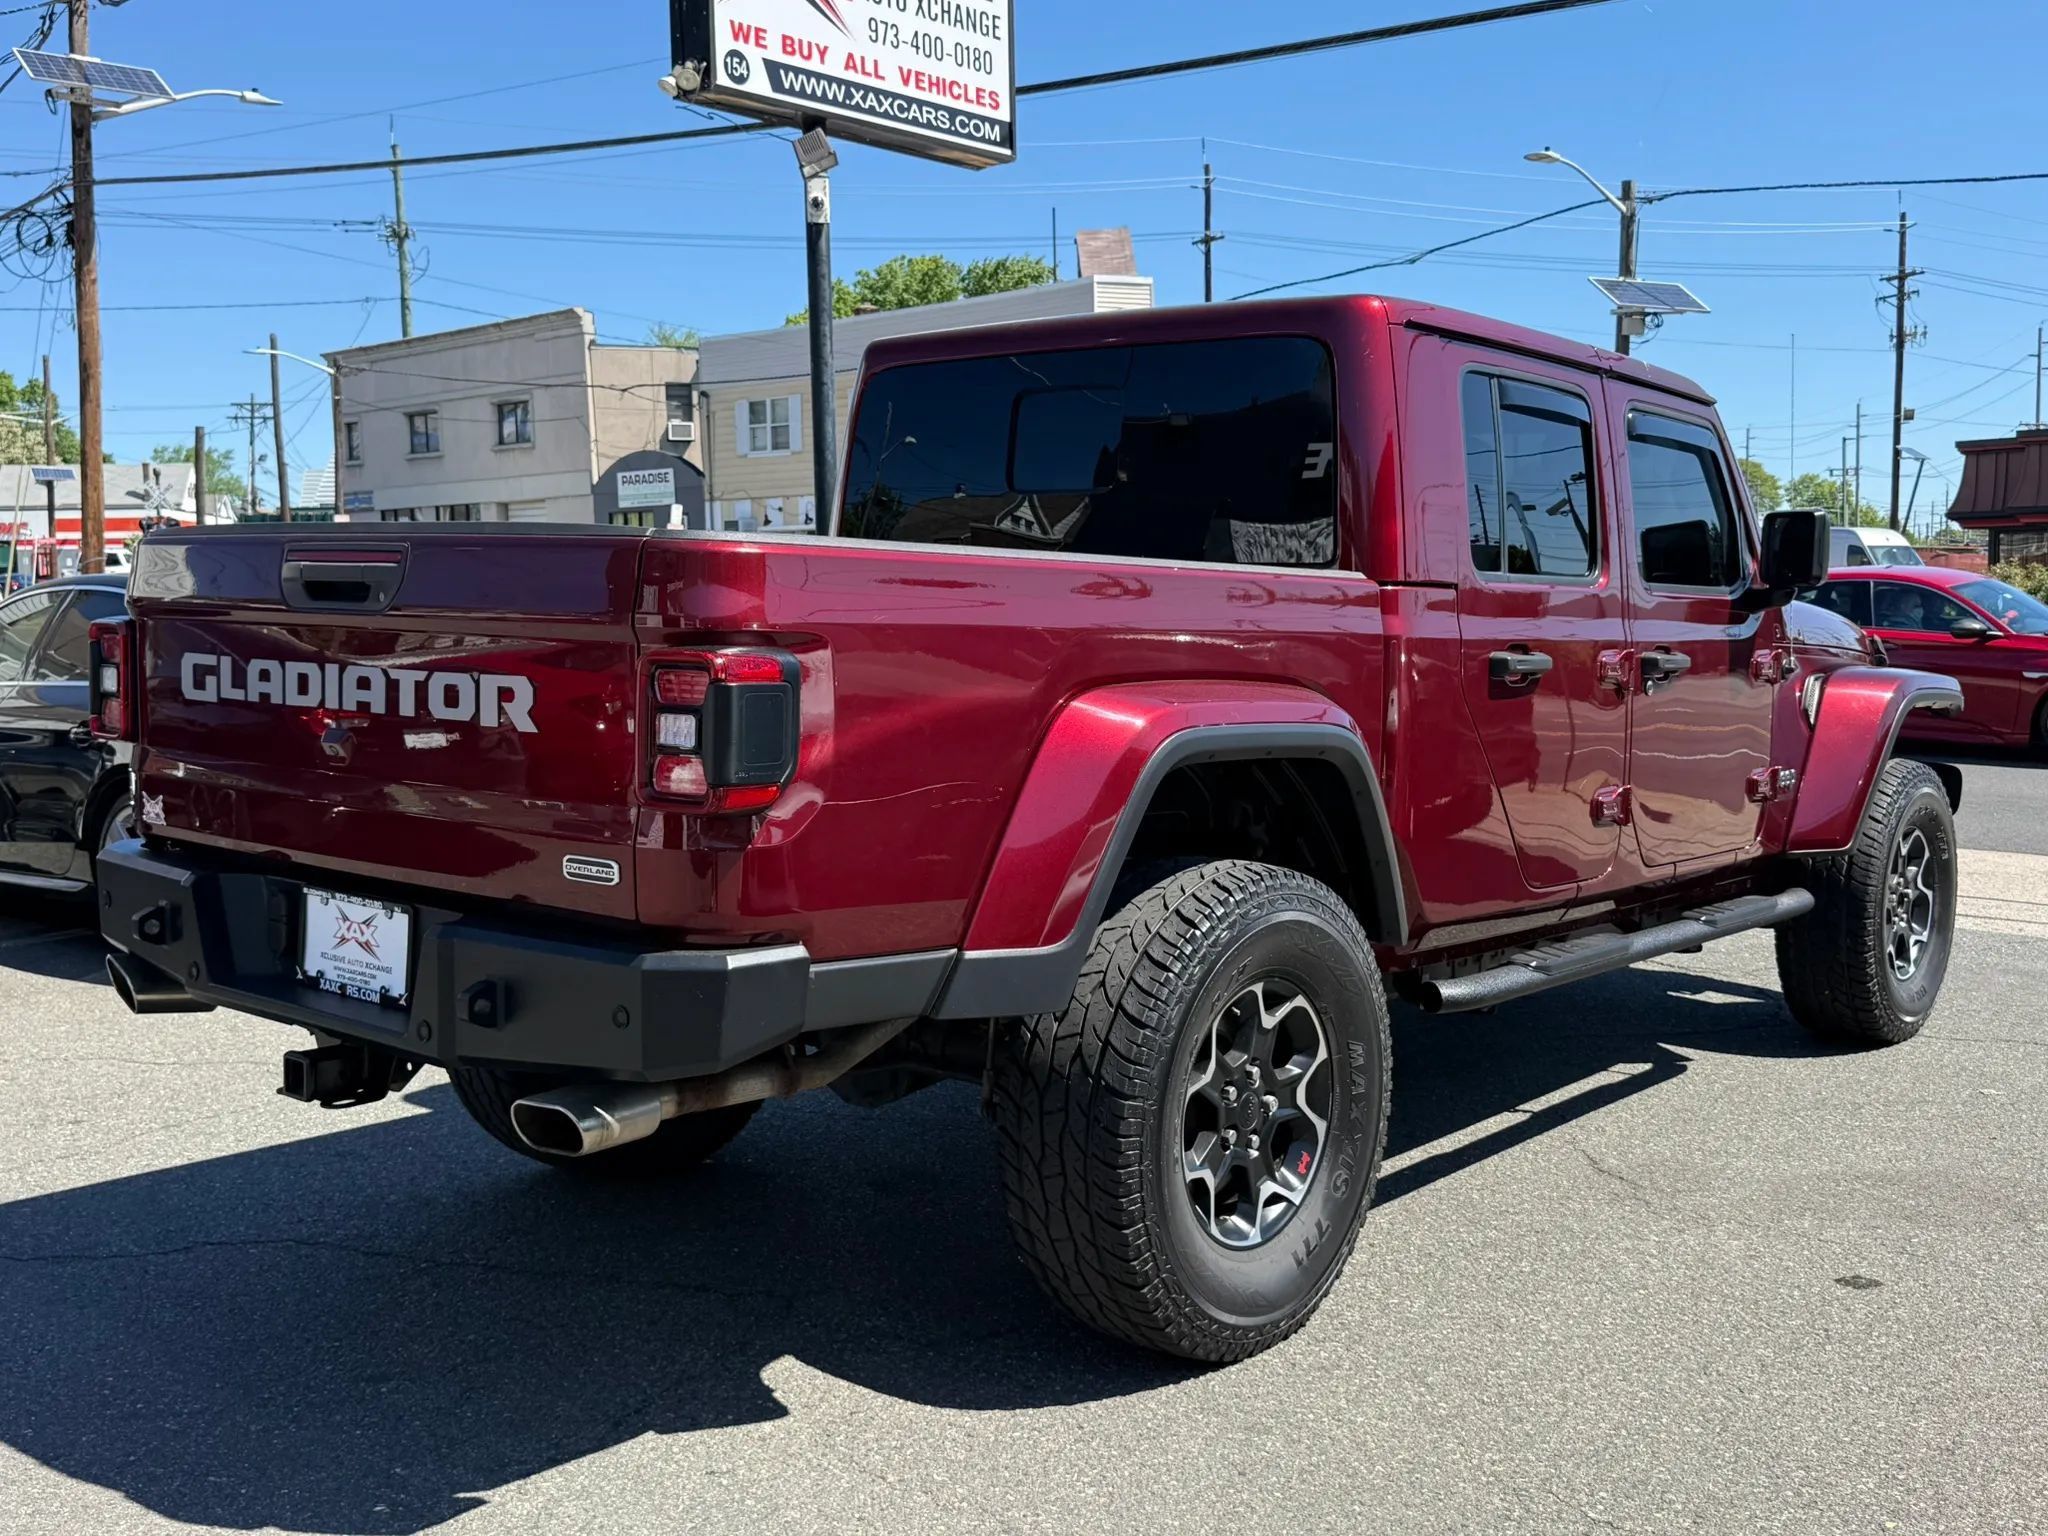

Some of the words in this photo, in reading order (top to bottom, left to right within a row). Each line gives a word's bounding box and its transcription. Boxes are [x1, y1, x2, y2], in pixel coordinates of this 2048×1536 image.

[915, 0, 1001, 41] XCHANGE
[868, 17, 993, 75] 973-400-0180
[726, 56, 748, 79] 154
[729, 19, 768, 50] WE
[781, 34, 829, 65] BUY
[844, 52, 885, 81] ALL
[898, 66, 1000, 111] VEHICLES
[780, 69, 1001, 142] WWW.XAXCARS.COM
[621, 472, 670, 487] PARADISE
[180, 652, 538, 733] GLADIATOR
[565, 864, 615, 877] OVERLAND
[335, 893, 383, 909] 973-400-0180
[333, 917, 380, 947] XAX
[320, 951, 346, 965] XCLUSIVE
[347, 957, 364, 968] AUTO
[364, 961, 393, 975] XCHANGE
[1330, 1039, 1367, 1200] MAXXIS
